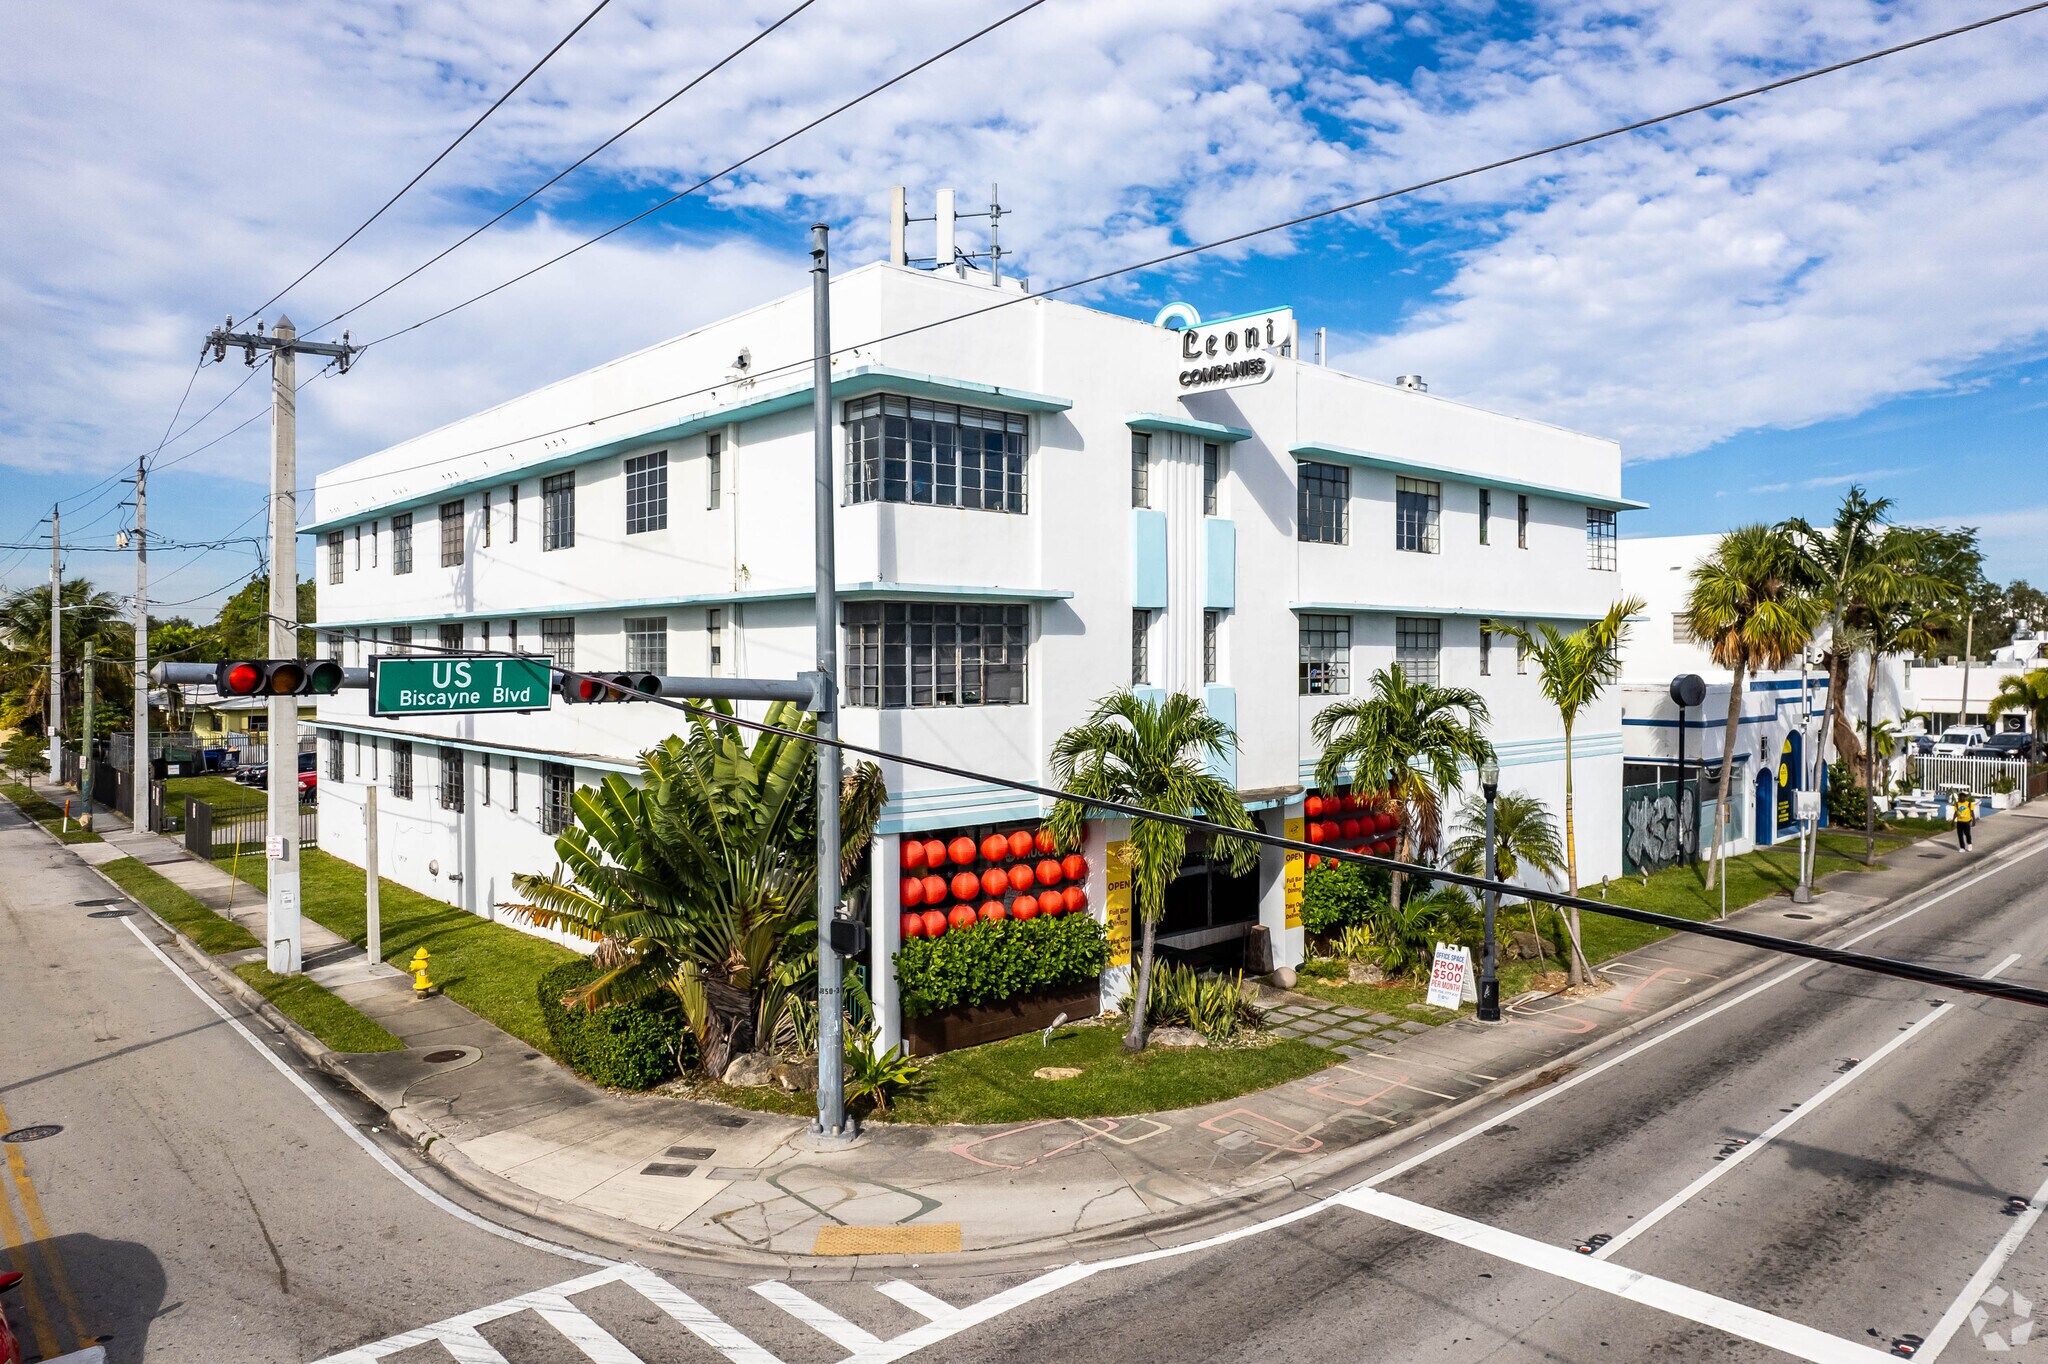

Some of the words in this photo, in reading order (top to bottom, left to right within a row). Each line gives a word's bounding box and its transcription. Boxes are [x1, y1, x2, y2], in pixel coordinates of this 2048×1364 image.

[1183, 318, 1275, 359] Leoni
[1179, 358, 1266, 386] COMPANIES
[432, 661, 472, 689] US
[495, 661, 503, 687] 1
[400, 689, 480, 708] Biscayne
[493, 687, 530, 703] Blvd
[1286, 852, 1303, 862] OPEN
[1108, 880, 1131, 892] OPEN
[1287, 886, 1302, 894] Dining
[1108, 909, 1119, 917] Full
[1436, 951, 1451, 960] OFFICE
[1451, 954, 1465, 963] SPACE
[1434, 959, 1464, 973] FROM
[1433, 969, 1462, 983] $500
[1431, 979, 1441, 988] PER
[1442, 981, 1460, 992] MONTH
